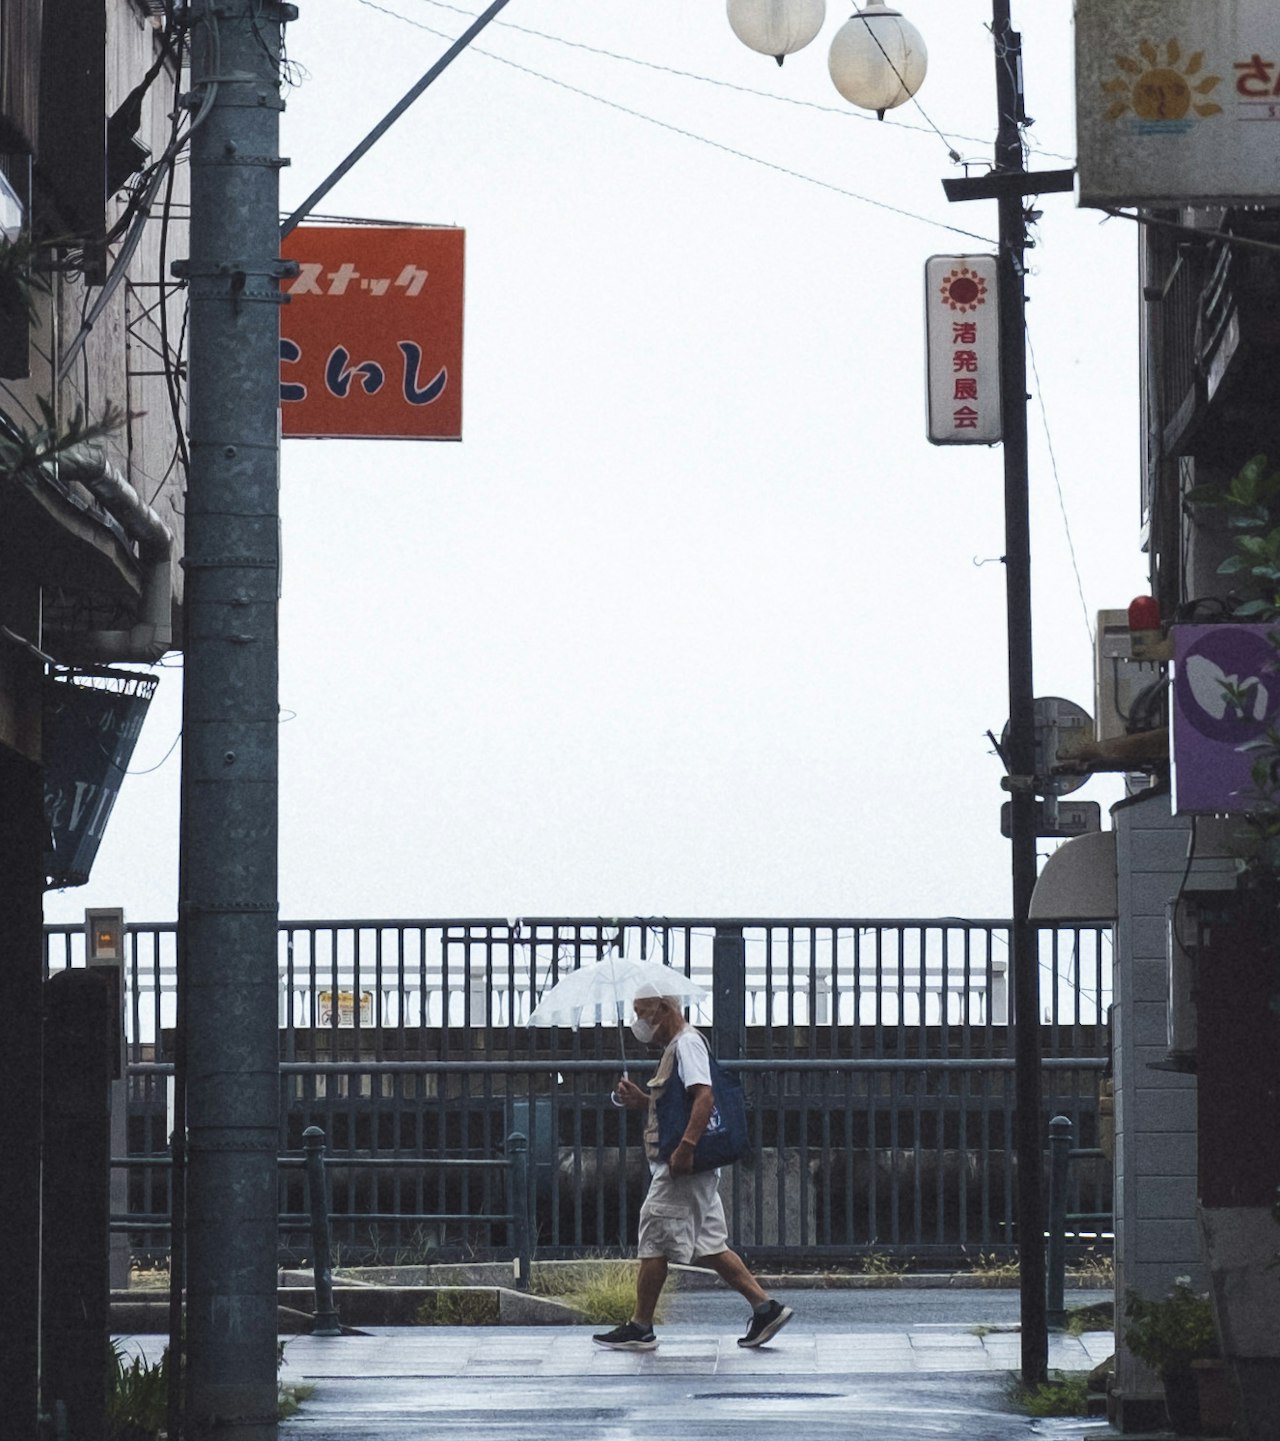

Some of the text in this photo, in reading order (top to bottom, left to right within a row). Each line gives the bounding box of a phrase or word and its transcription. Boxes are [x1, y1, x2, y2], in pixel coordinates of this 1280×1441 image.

[286, 263, 429, 296] スナック
[952, 322, 978, 429] 渚発展会
